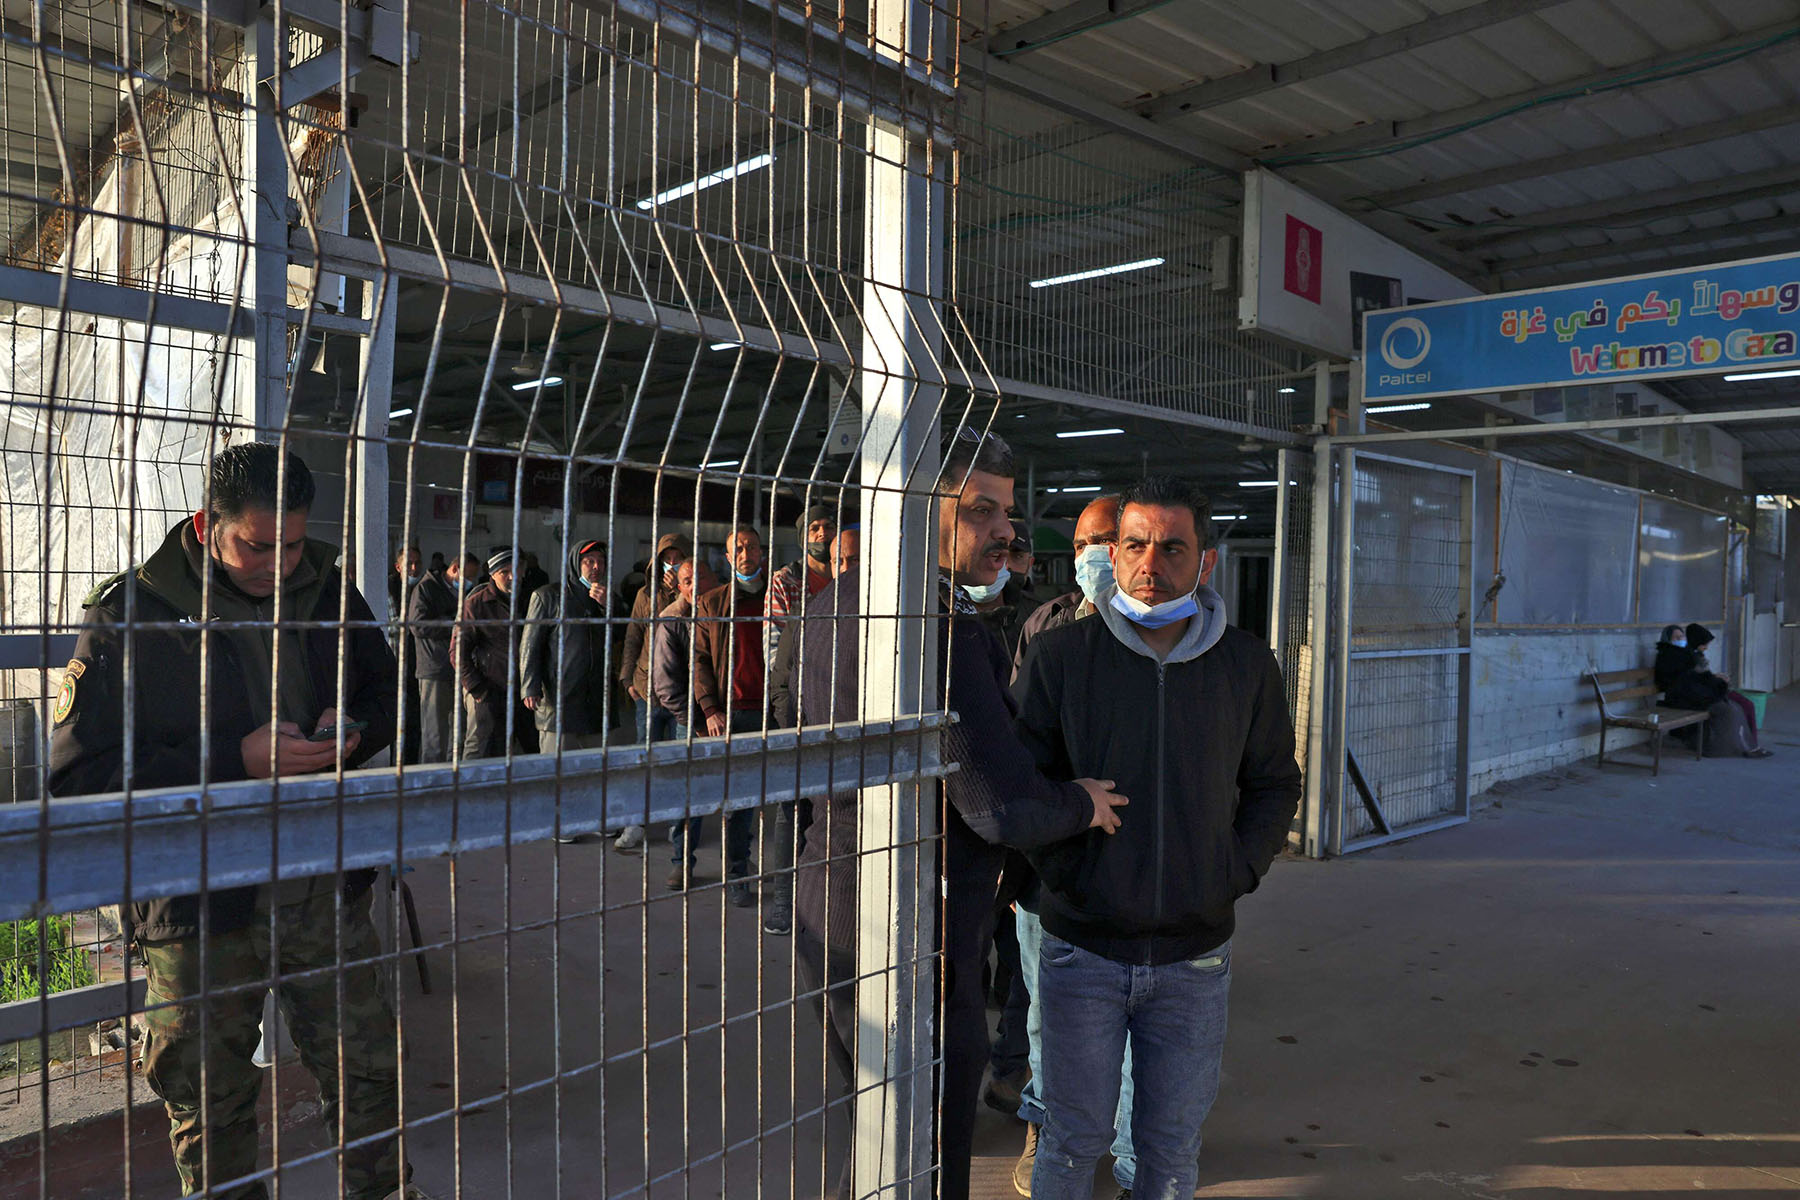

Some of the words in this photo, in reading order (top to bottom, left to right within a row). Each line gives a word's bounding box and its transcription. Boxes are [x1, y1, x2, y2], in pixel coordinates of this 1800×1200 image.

[1500, 306, 1547, 343] غزة
[1554, 298, 1608, 342] في
[1616, 291, 1681, 333] بكم
[1570, 341, 1687, 375] Welcome
[1688, 335, 1722, 364] to
[1724, 328, 1797, 362] Gaza
[1379, 370, 1431, 387] Paltel
